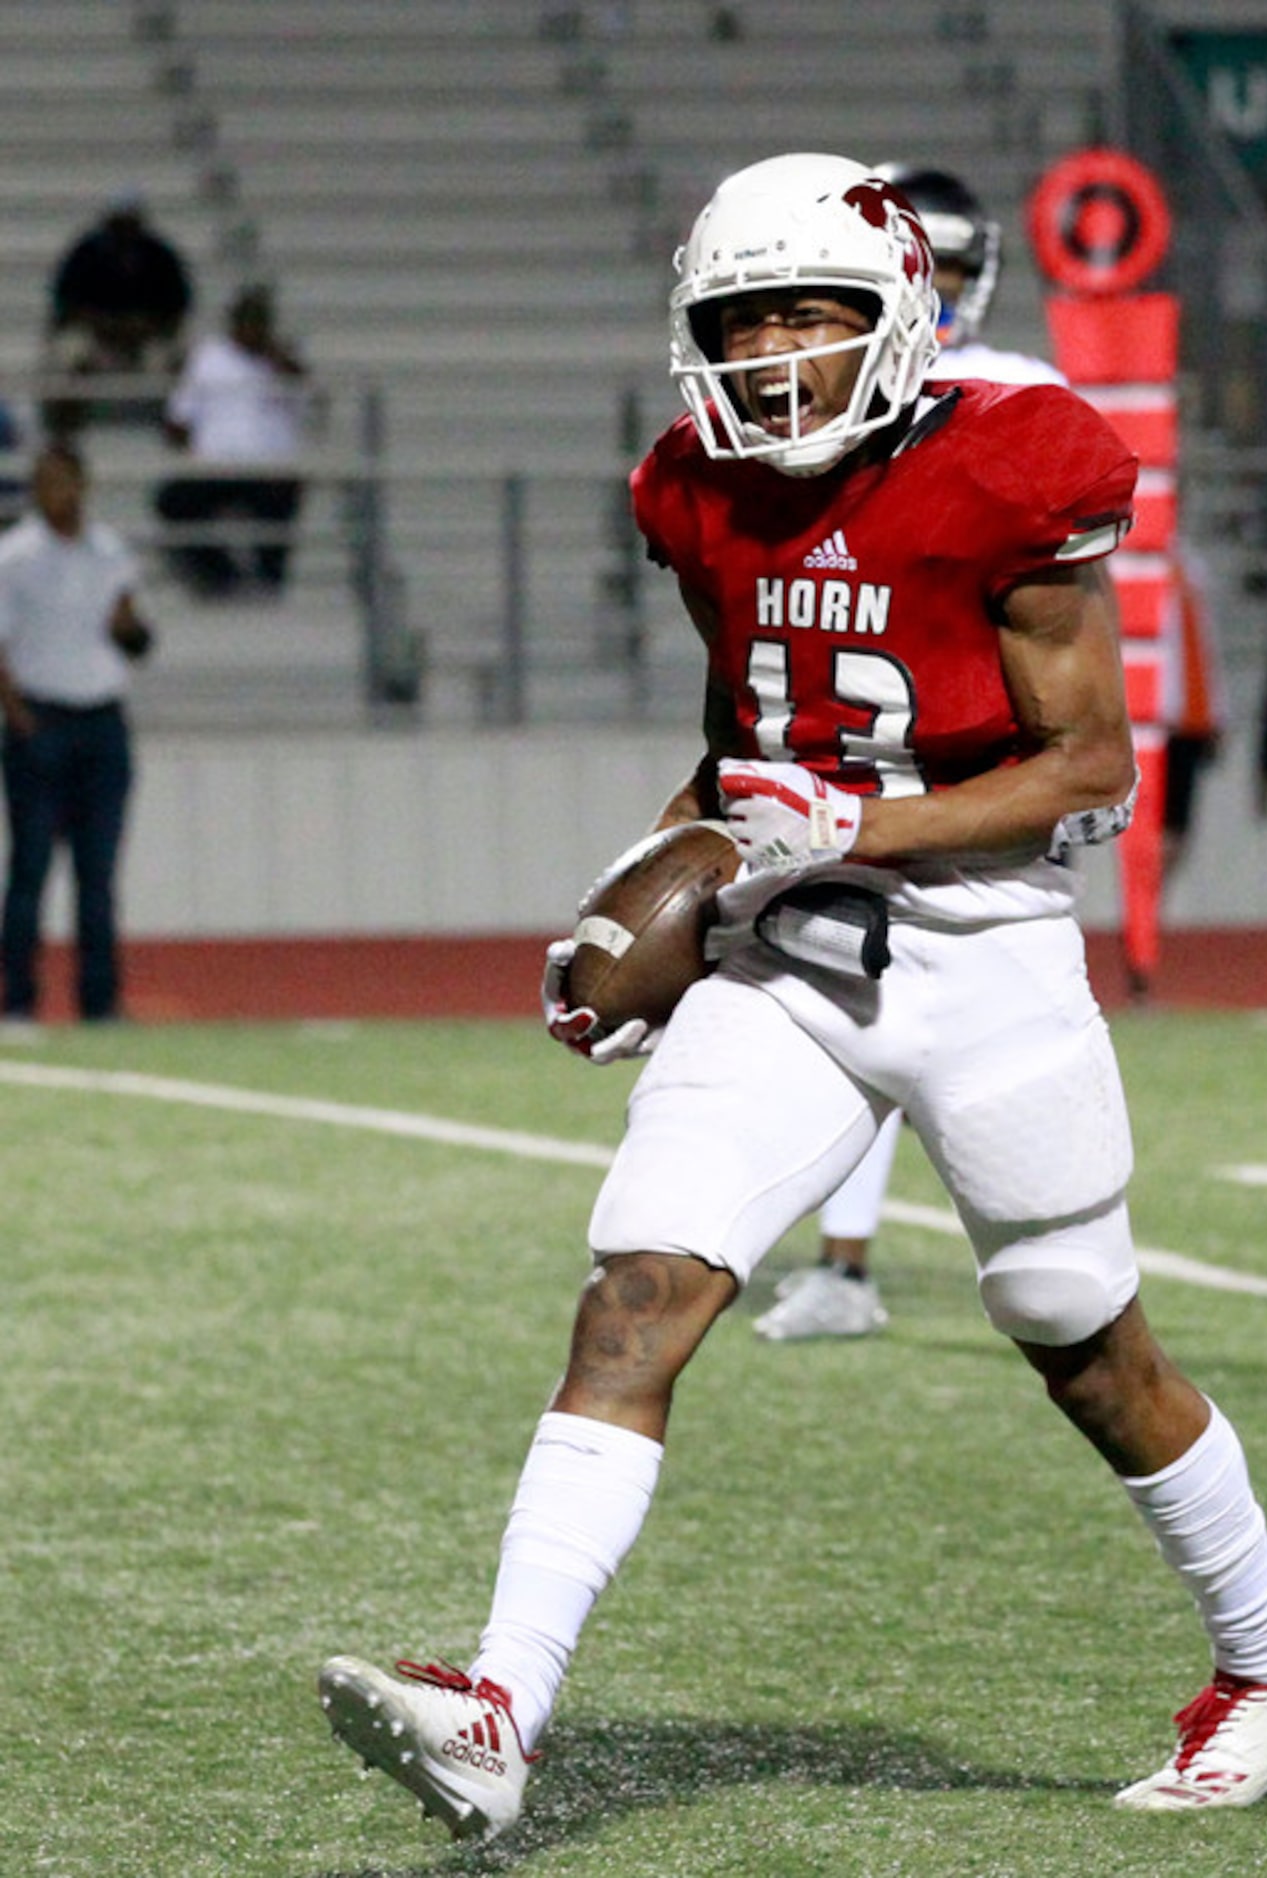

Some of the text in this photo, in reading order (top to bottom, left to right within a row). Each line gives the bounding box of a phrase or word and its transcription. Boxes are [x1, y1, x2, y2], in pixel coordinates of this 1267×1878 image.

[803, 553, 858, 572] adidas
[755, 577, 892, 635] HORN
[745, 637, 930, 801] 13
[442, 1738, 508, 1777] adidas
